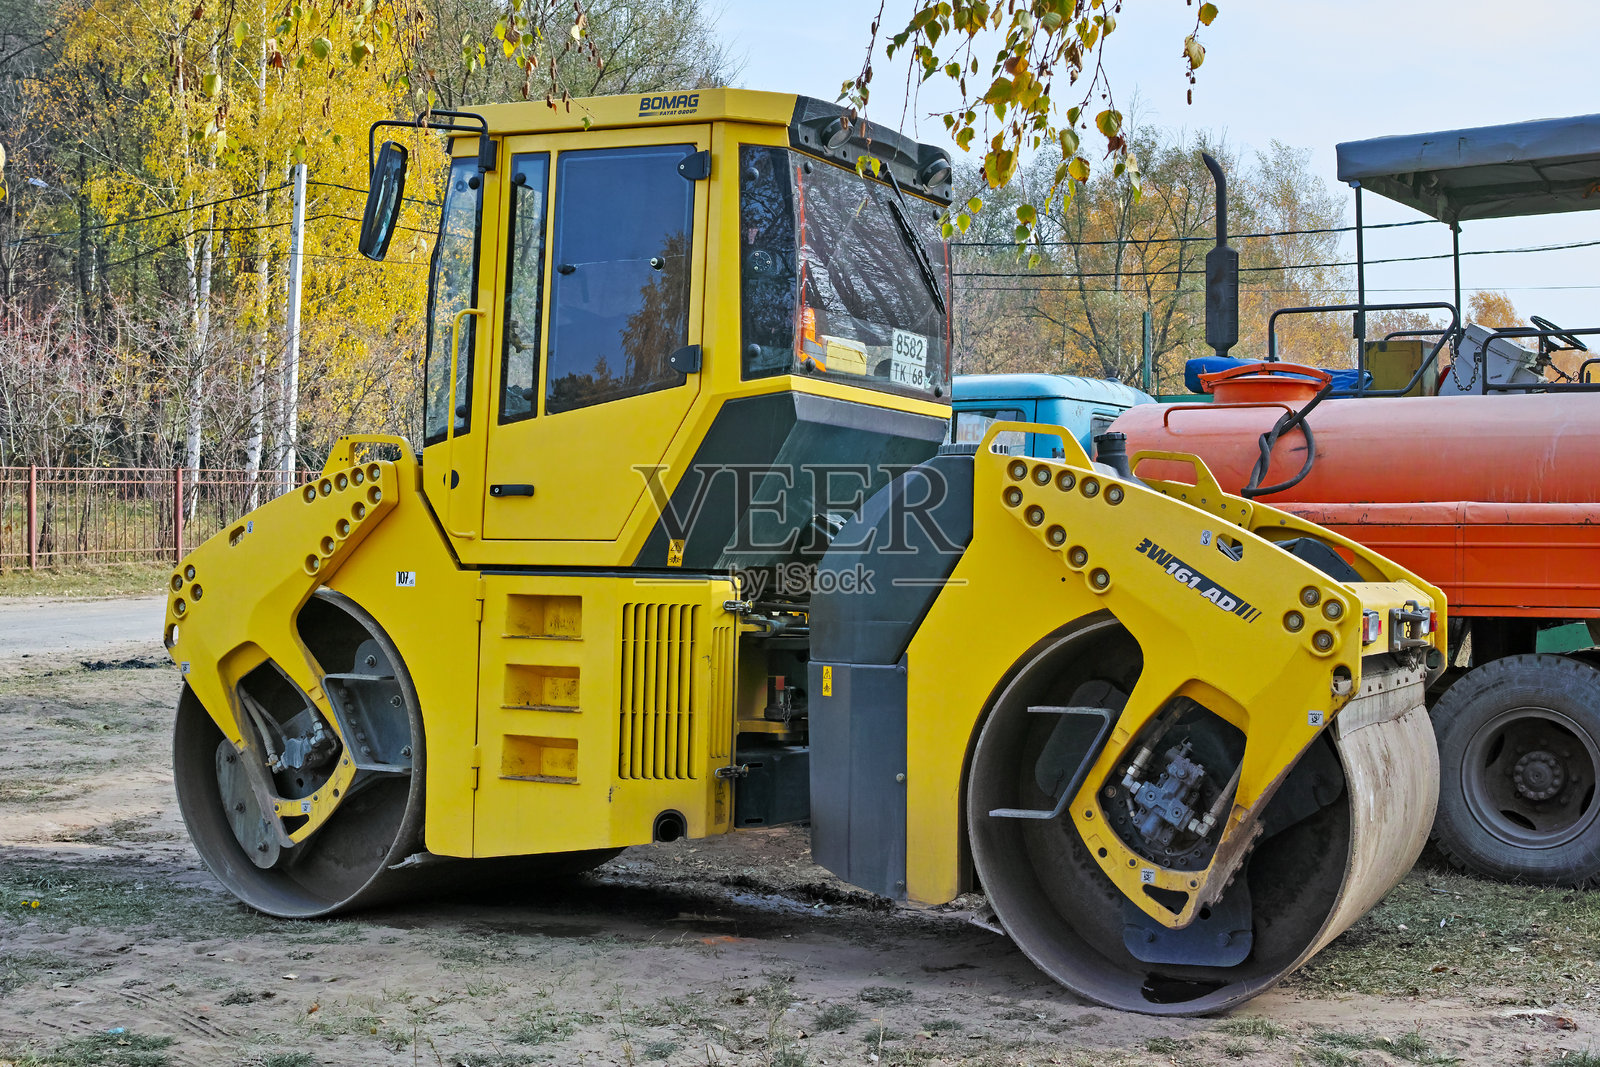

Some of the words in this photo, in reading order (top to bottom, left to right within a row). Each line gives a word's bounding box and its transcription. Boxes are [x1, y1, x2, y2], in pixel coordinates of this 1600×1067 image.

[640, 94, 699, 111] BOMAG
[896, 334, 923, 361] 8582
[912, 368, 923, 386] 68
[398, 571, 409, 585] 107
